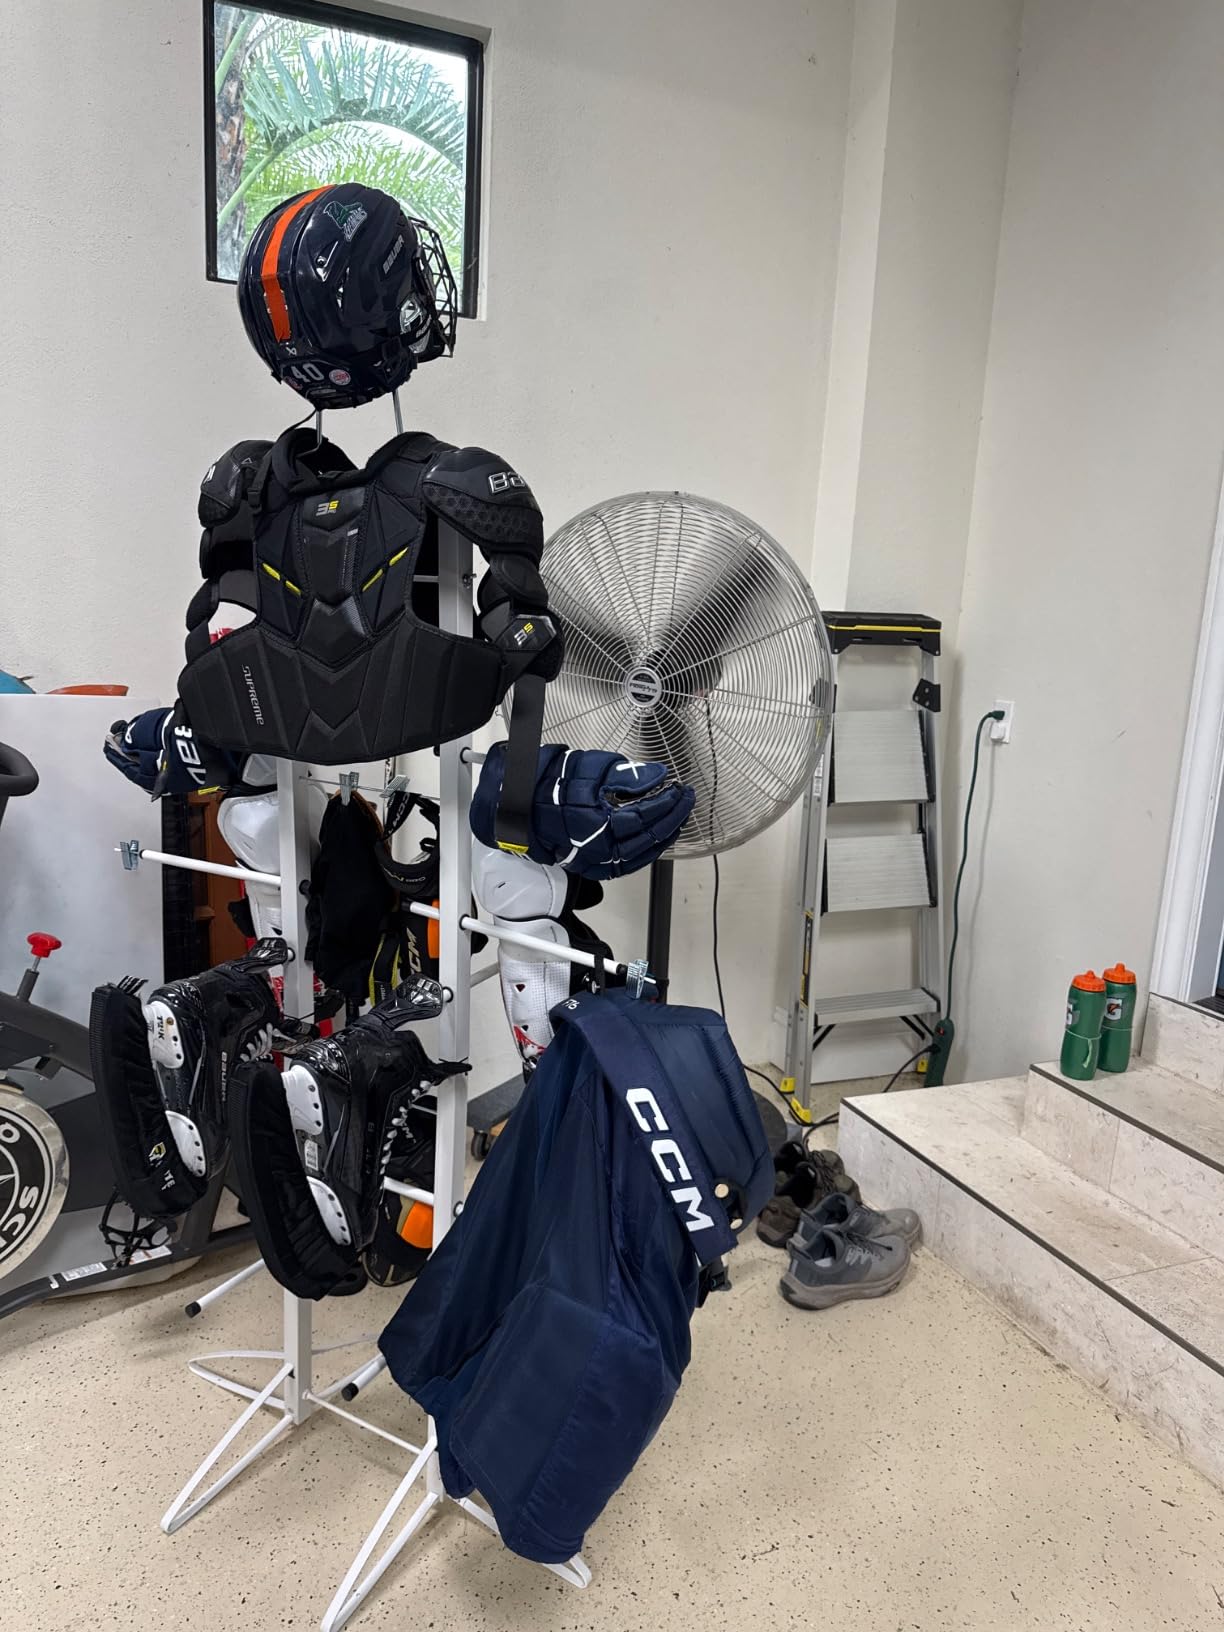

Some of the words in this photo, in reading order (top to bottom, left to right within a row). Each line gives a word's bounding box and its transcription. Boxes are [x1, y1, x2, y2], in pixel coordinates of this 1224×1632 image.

[291, 363, 325, 383] 40
[406, 927, 422, 975] CM
[626, 1087, 715, 1233] CCM
